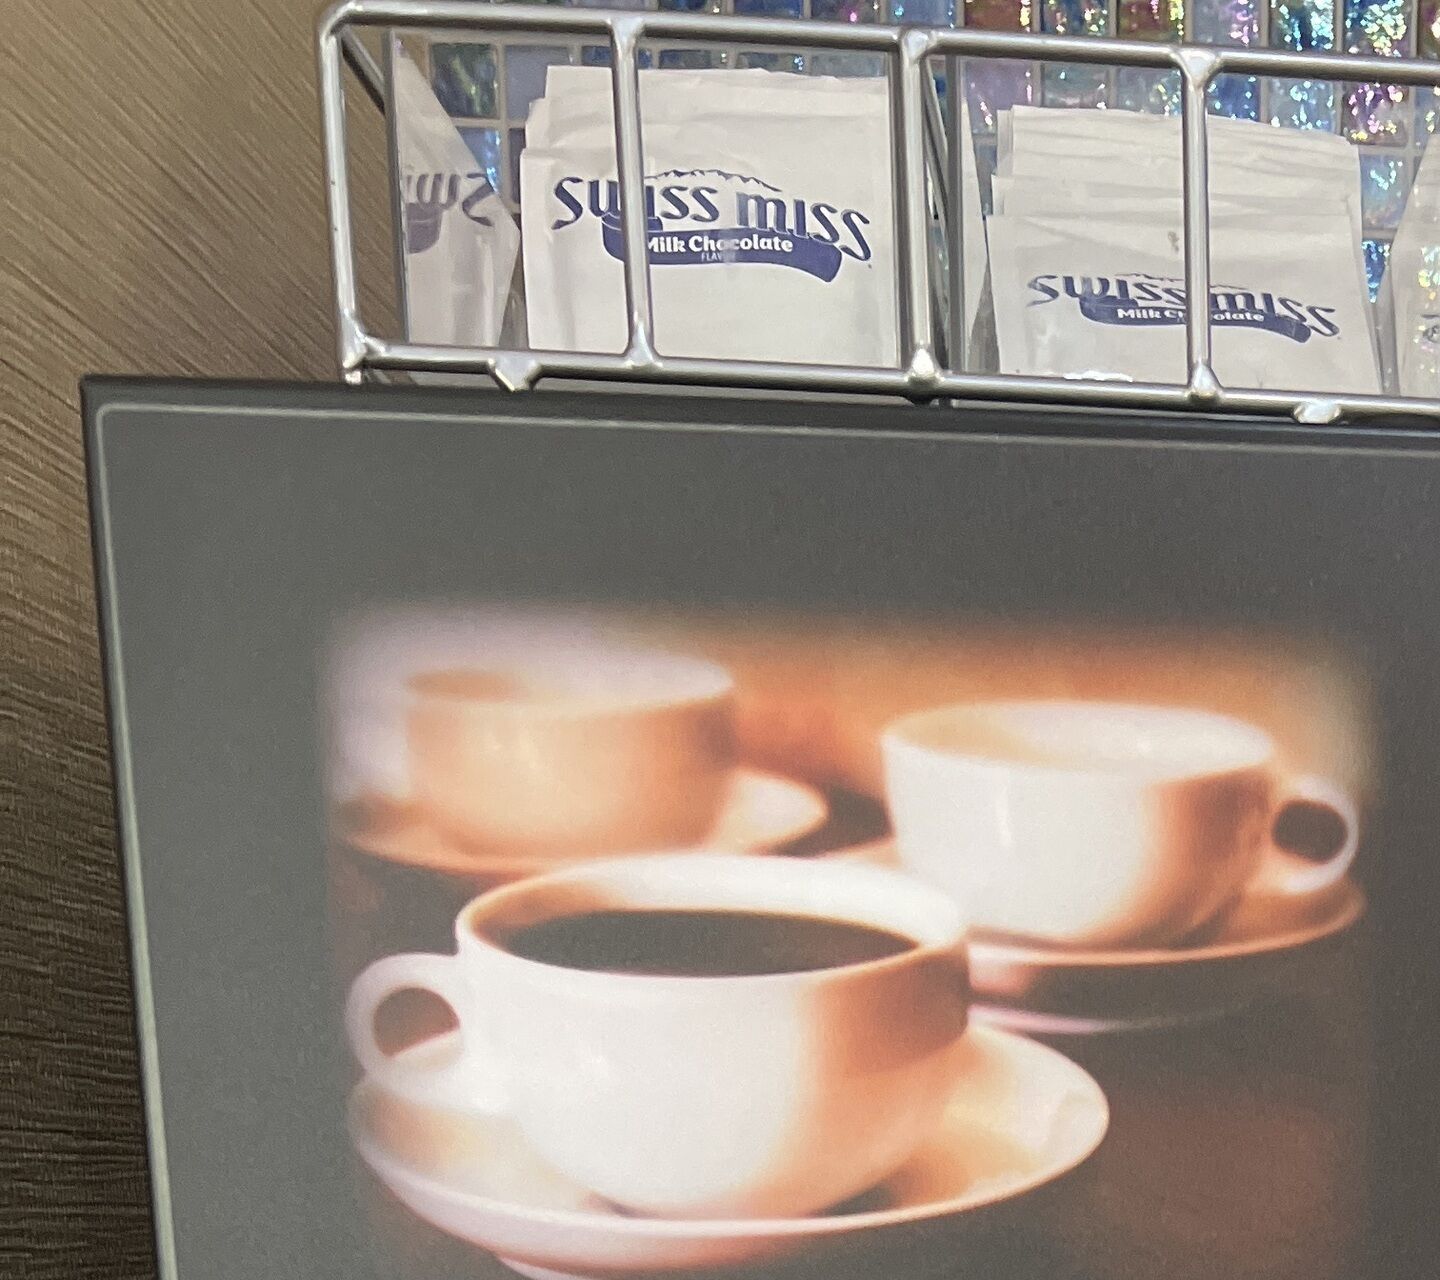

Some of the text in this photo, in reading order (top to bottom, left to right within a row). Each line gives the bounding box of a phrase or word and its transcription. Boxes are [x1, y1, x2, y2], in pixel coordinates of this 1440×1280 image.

[648, 234, 794, 253] Milk Chocolate
[1116, 308, 1162, 319] Milk
